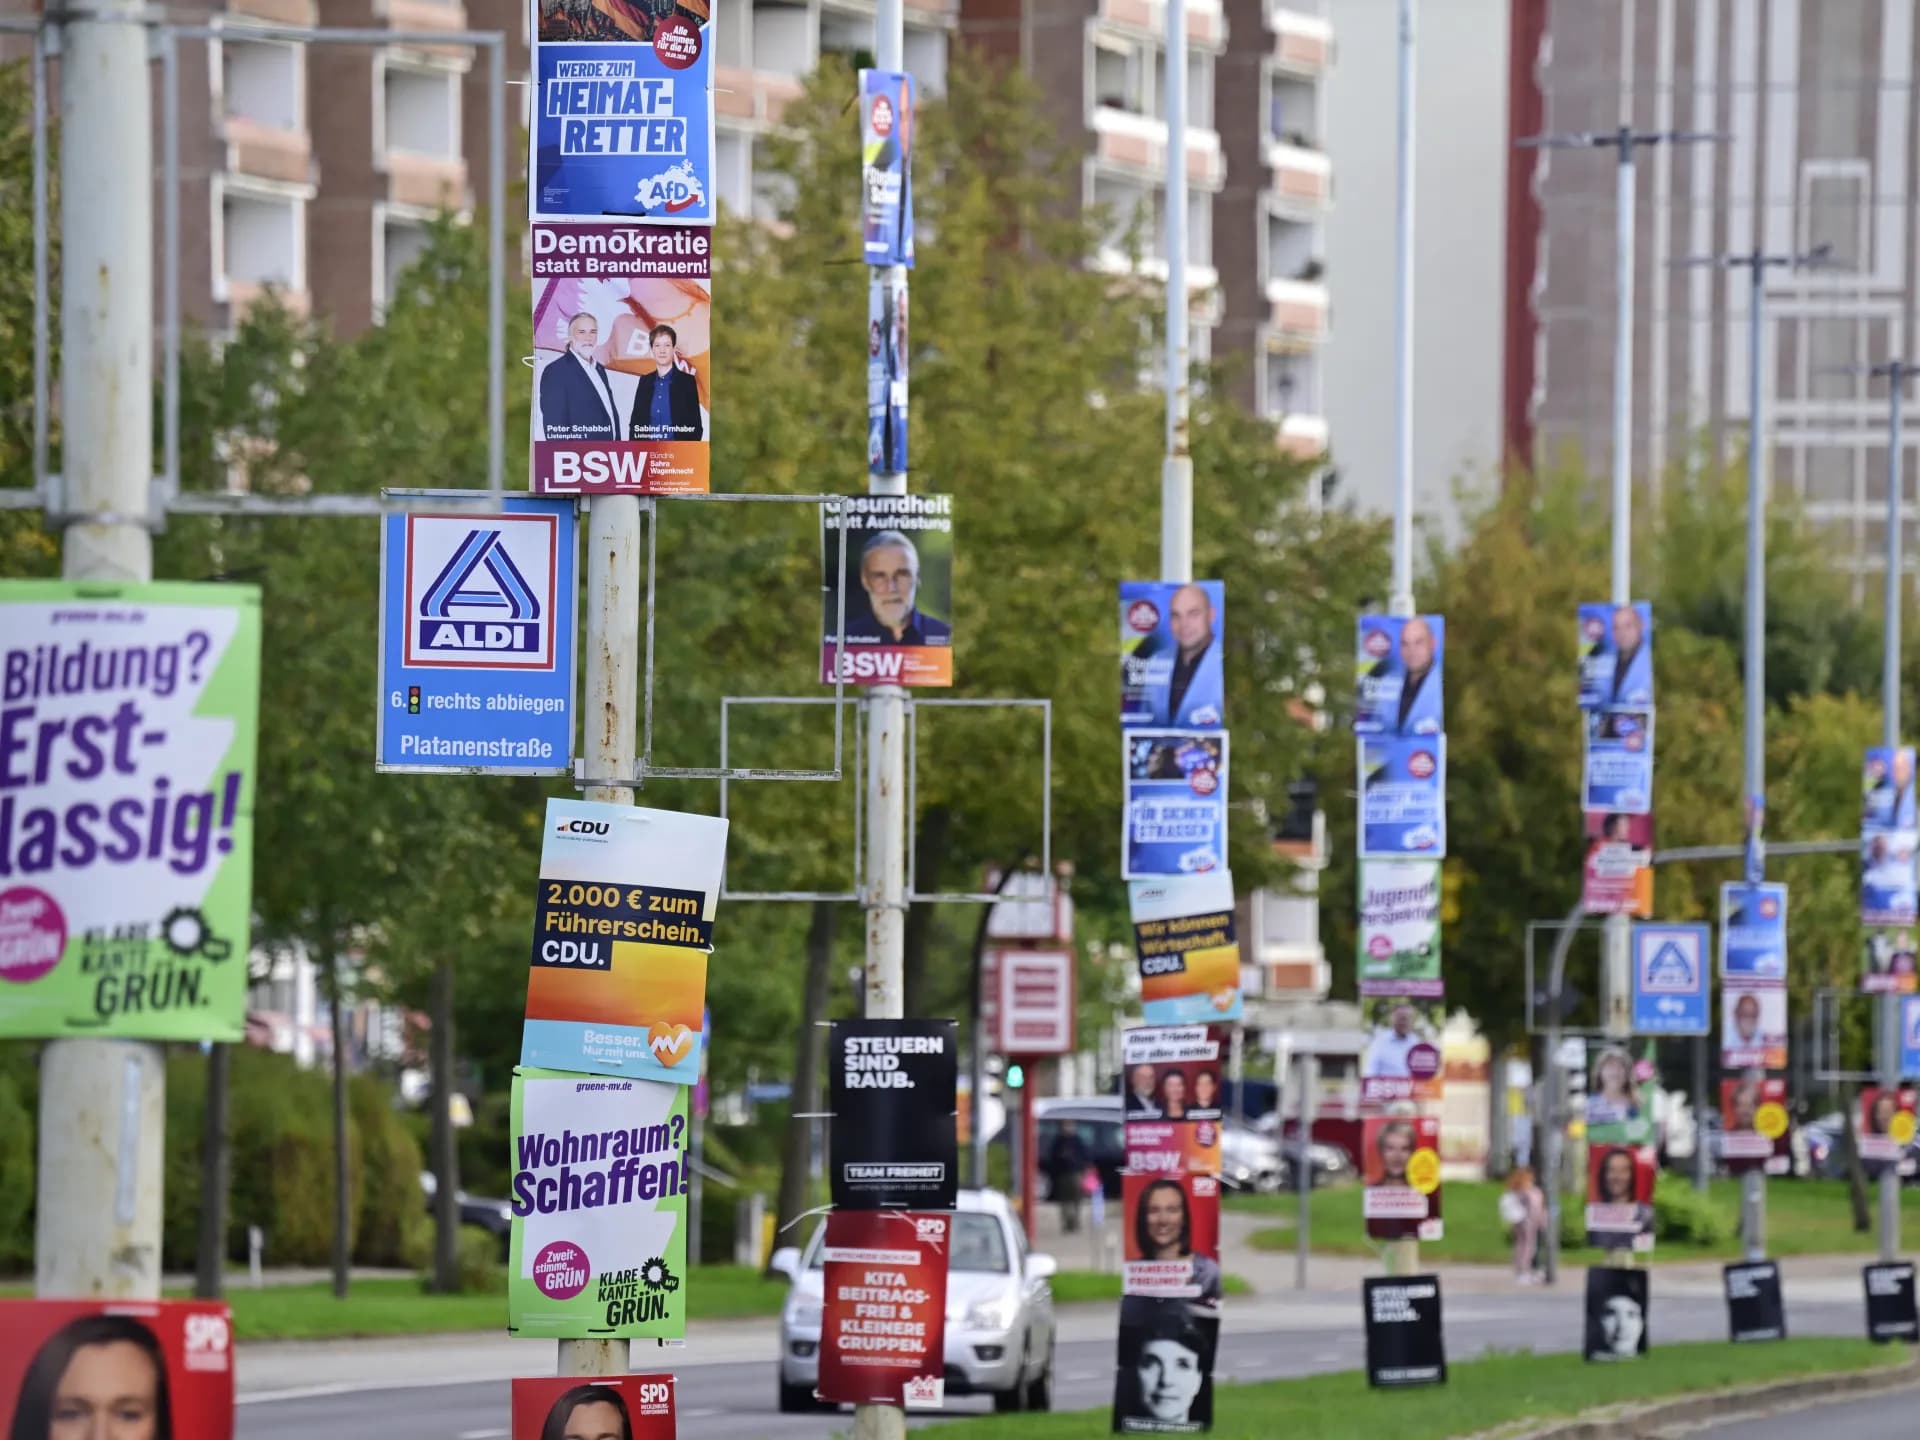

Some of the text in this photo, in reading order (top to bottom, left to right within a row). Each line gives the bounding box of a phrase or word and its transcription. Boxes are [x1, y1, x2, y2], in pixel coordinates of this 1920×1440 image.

[661, 32, 695, 45] Stimmen
[673, 25, 688, 36] Alle
[657, 40, 669, 50] für
[683, 45, 697, 54] AfD
[559, 62, 632, 77] WERDE ZUM
[548, 81, 672, 115] HEIMAT-
[564, 119, 684, 153] RETTER
[650, 182, 688, 200] AfD
[534, 229, 708, 254] Demokratie
[535, 259, 708, 274] statt Brandmauern!
[547, 425, 569, 433] Peter
[634, 425, 660, 433] Sabine
[554, 451, 648, 483] BSW
[825, 515, 951, 533] sttt Aufrüstung
[430, 623, 525, 649] ALDI
[4, 631, 211, 700] Bildung?
[835, 652, 904, 677] BSW
[391, 691, 565, 715] 6. rechts abbiegen
[0, 700, 167, 788] Erst-
[401, 734, 553, 759] Platanenstraße
[570, 820, 609, 836] CDU
[547, 884, 698, 915] 2.000 € zum
[545, 911, 705, 944] Führerschein.
[541, 940, 605, 966] CDU.
[95, 960, 210, 1018] GRÜN.
[583, 1030, 641, 1047] Besser.
[844, 1037, 944, 1054] STEUERN
[583, 1045, 649, 1060] Nur mit uns.
[844, 1055, 900, 1071] SIND
[576, 1082, 632, 1092] gruene-mv.de
[845, 1071, 916, 1088] RAUB.
[517, 1115, 685, 1170] Wohnraum?
[849, 1166, 940, 1178] TEAM FREIHEIT
[511, 1150, 688, 1217] Schaffen!
[917, 1219, 945, 1233] SPD
[547, 1249, 577, 1263] Zweit-
[535, 1261, 568, 1274] stimme
[545, 1268, 585, 1290] GRÜN
[600, 1268, 638, 1287] KLARE
[864, 1271, 908, 1287] KITA
[597, 1284, 639, 1302] KANTE
[838, 1287, 930, 1303] BEITRAGS-
[606, 1291, 670, 1327] GRÜN.
[855, 1303, 912, 1319] FREI &
[840, 1320, 926, 1336] KLEINERE
[837, 1335, 927, 1353] GRUPPEN.
[640, 1383, 669, 1404] SPD
